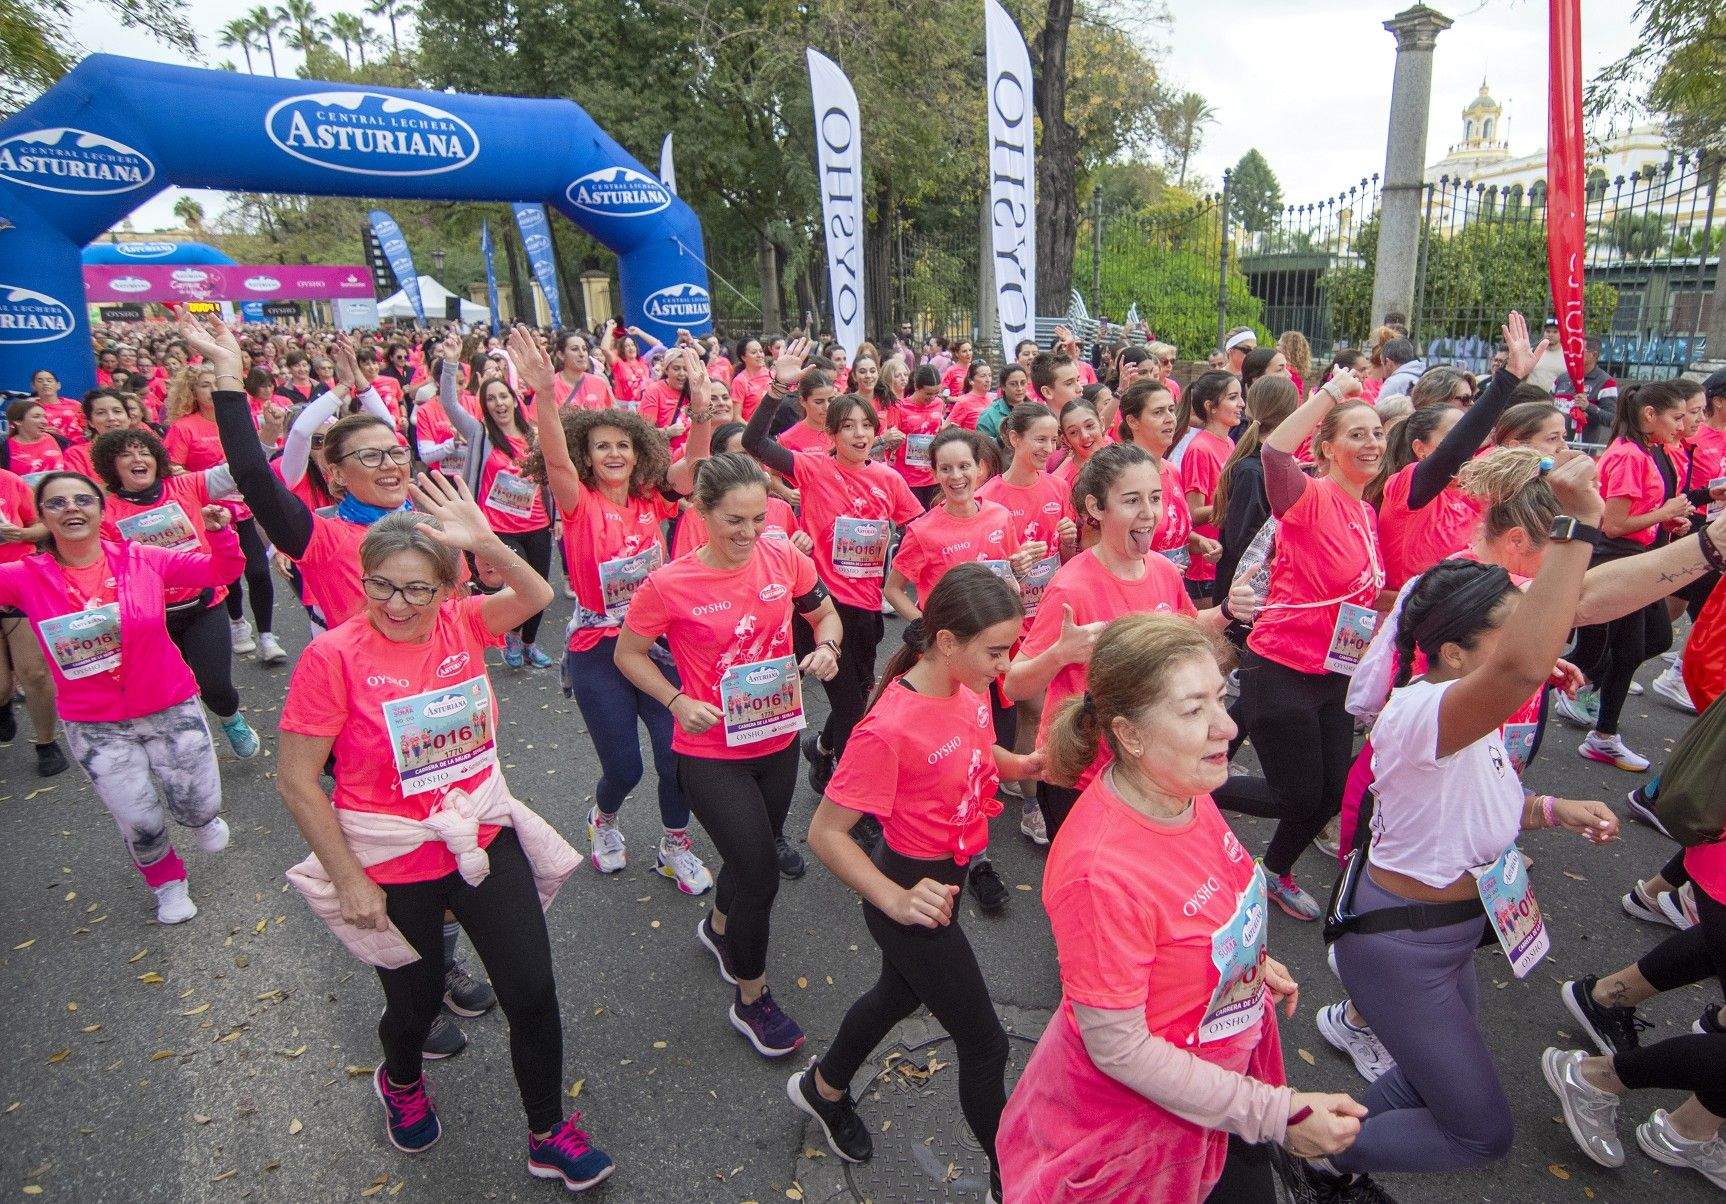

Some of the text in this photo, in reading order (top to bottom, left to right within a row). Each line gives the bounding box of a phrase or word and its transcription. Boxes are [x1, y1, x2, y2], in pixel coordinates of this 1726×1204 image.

[316, 110, 456, 132] CENTRAL LECHERA
[286, 109, 466, 159] ASTURIANA
[0, 147, 143, 182] ASTURIANA
[576, 186, 667, 204] ASTURIANA
[942, 541, 971, 555] OYSHO
[693, 601, 732, 616] OYSHO
[82, 633, 112, 650] 016
[427, 700, 467, 716] ASTURIANA
[752, 693, 781, 711] 016
[433, 725, 473, 749] 016
[736, 729, 764, 741] OYSHO
[927, 735, 962, 765] OYSHO
[414, 765, 440, 776] CARRERA
[447, 759, 455, 767] LA
[412, 772, 449, 789] OYSHO
[1182, 876, 1221, 917] OYSHO
[1521, 940, 1544, 968] OYSHO
[1215, 1003, 1242, 1017] CARRERA
[1243, 999, 1252, 1008] DE
[1209, 1014, 1251, 1034] OYSHO
